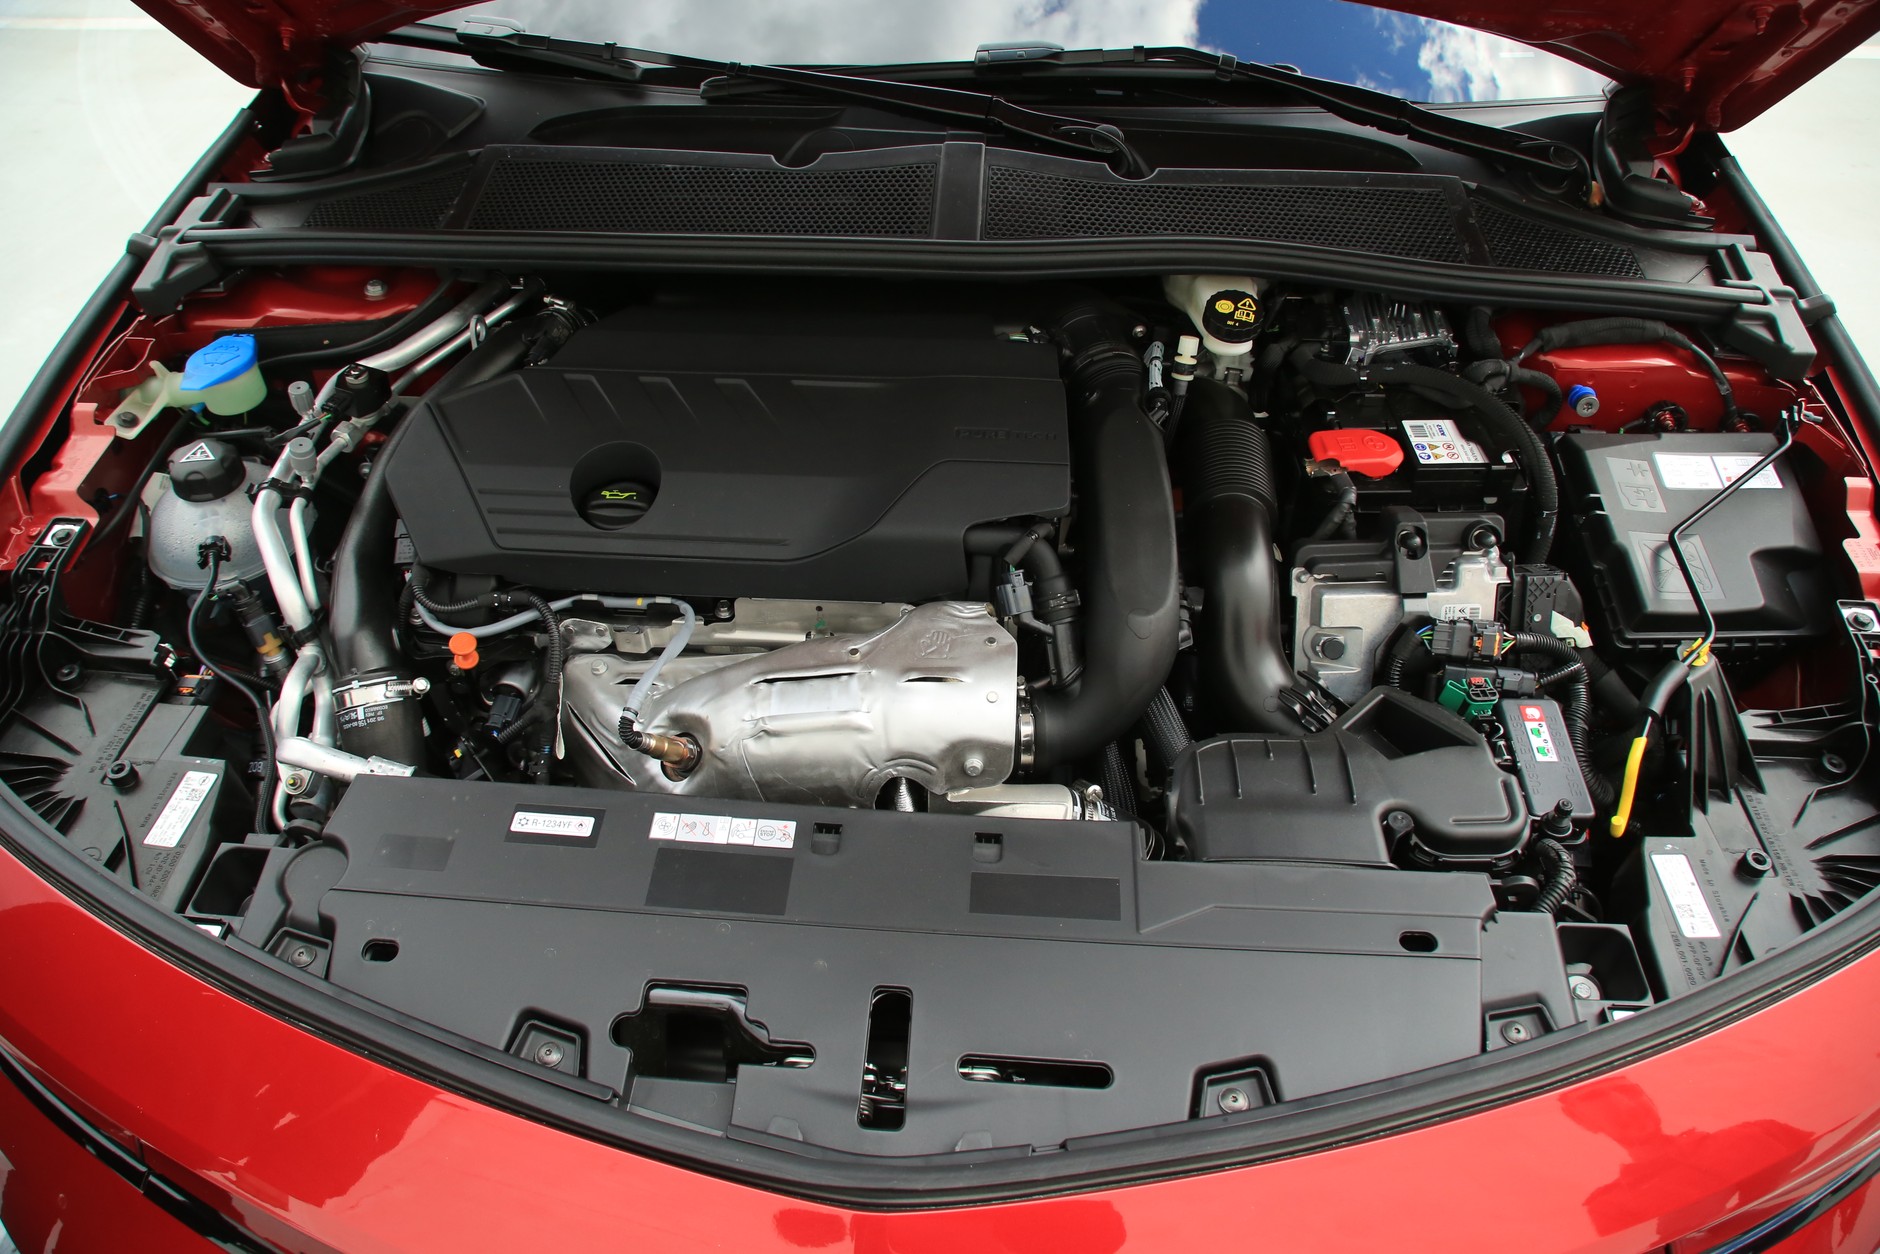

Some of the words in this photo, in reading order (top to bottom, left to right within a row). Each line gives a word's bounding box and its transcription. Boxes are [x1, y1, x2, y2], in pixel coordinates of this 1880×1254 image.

[532, 818, 572, 829] R-1234YF
[1700, 860, 1710, 876] Made
[1712, 890, 1730, 922] Slovakia
